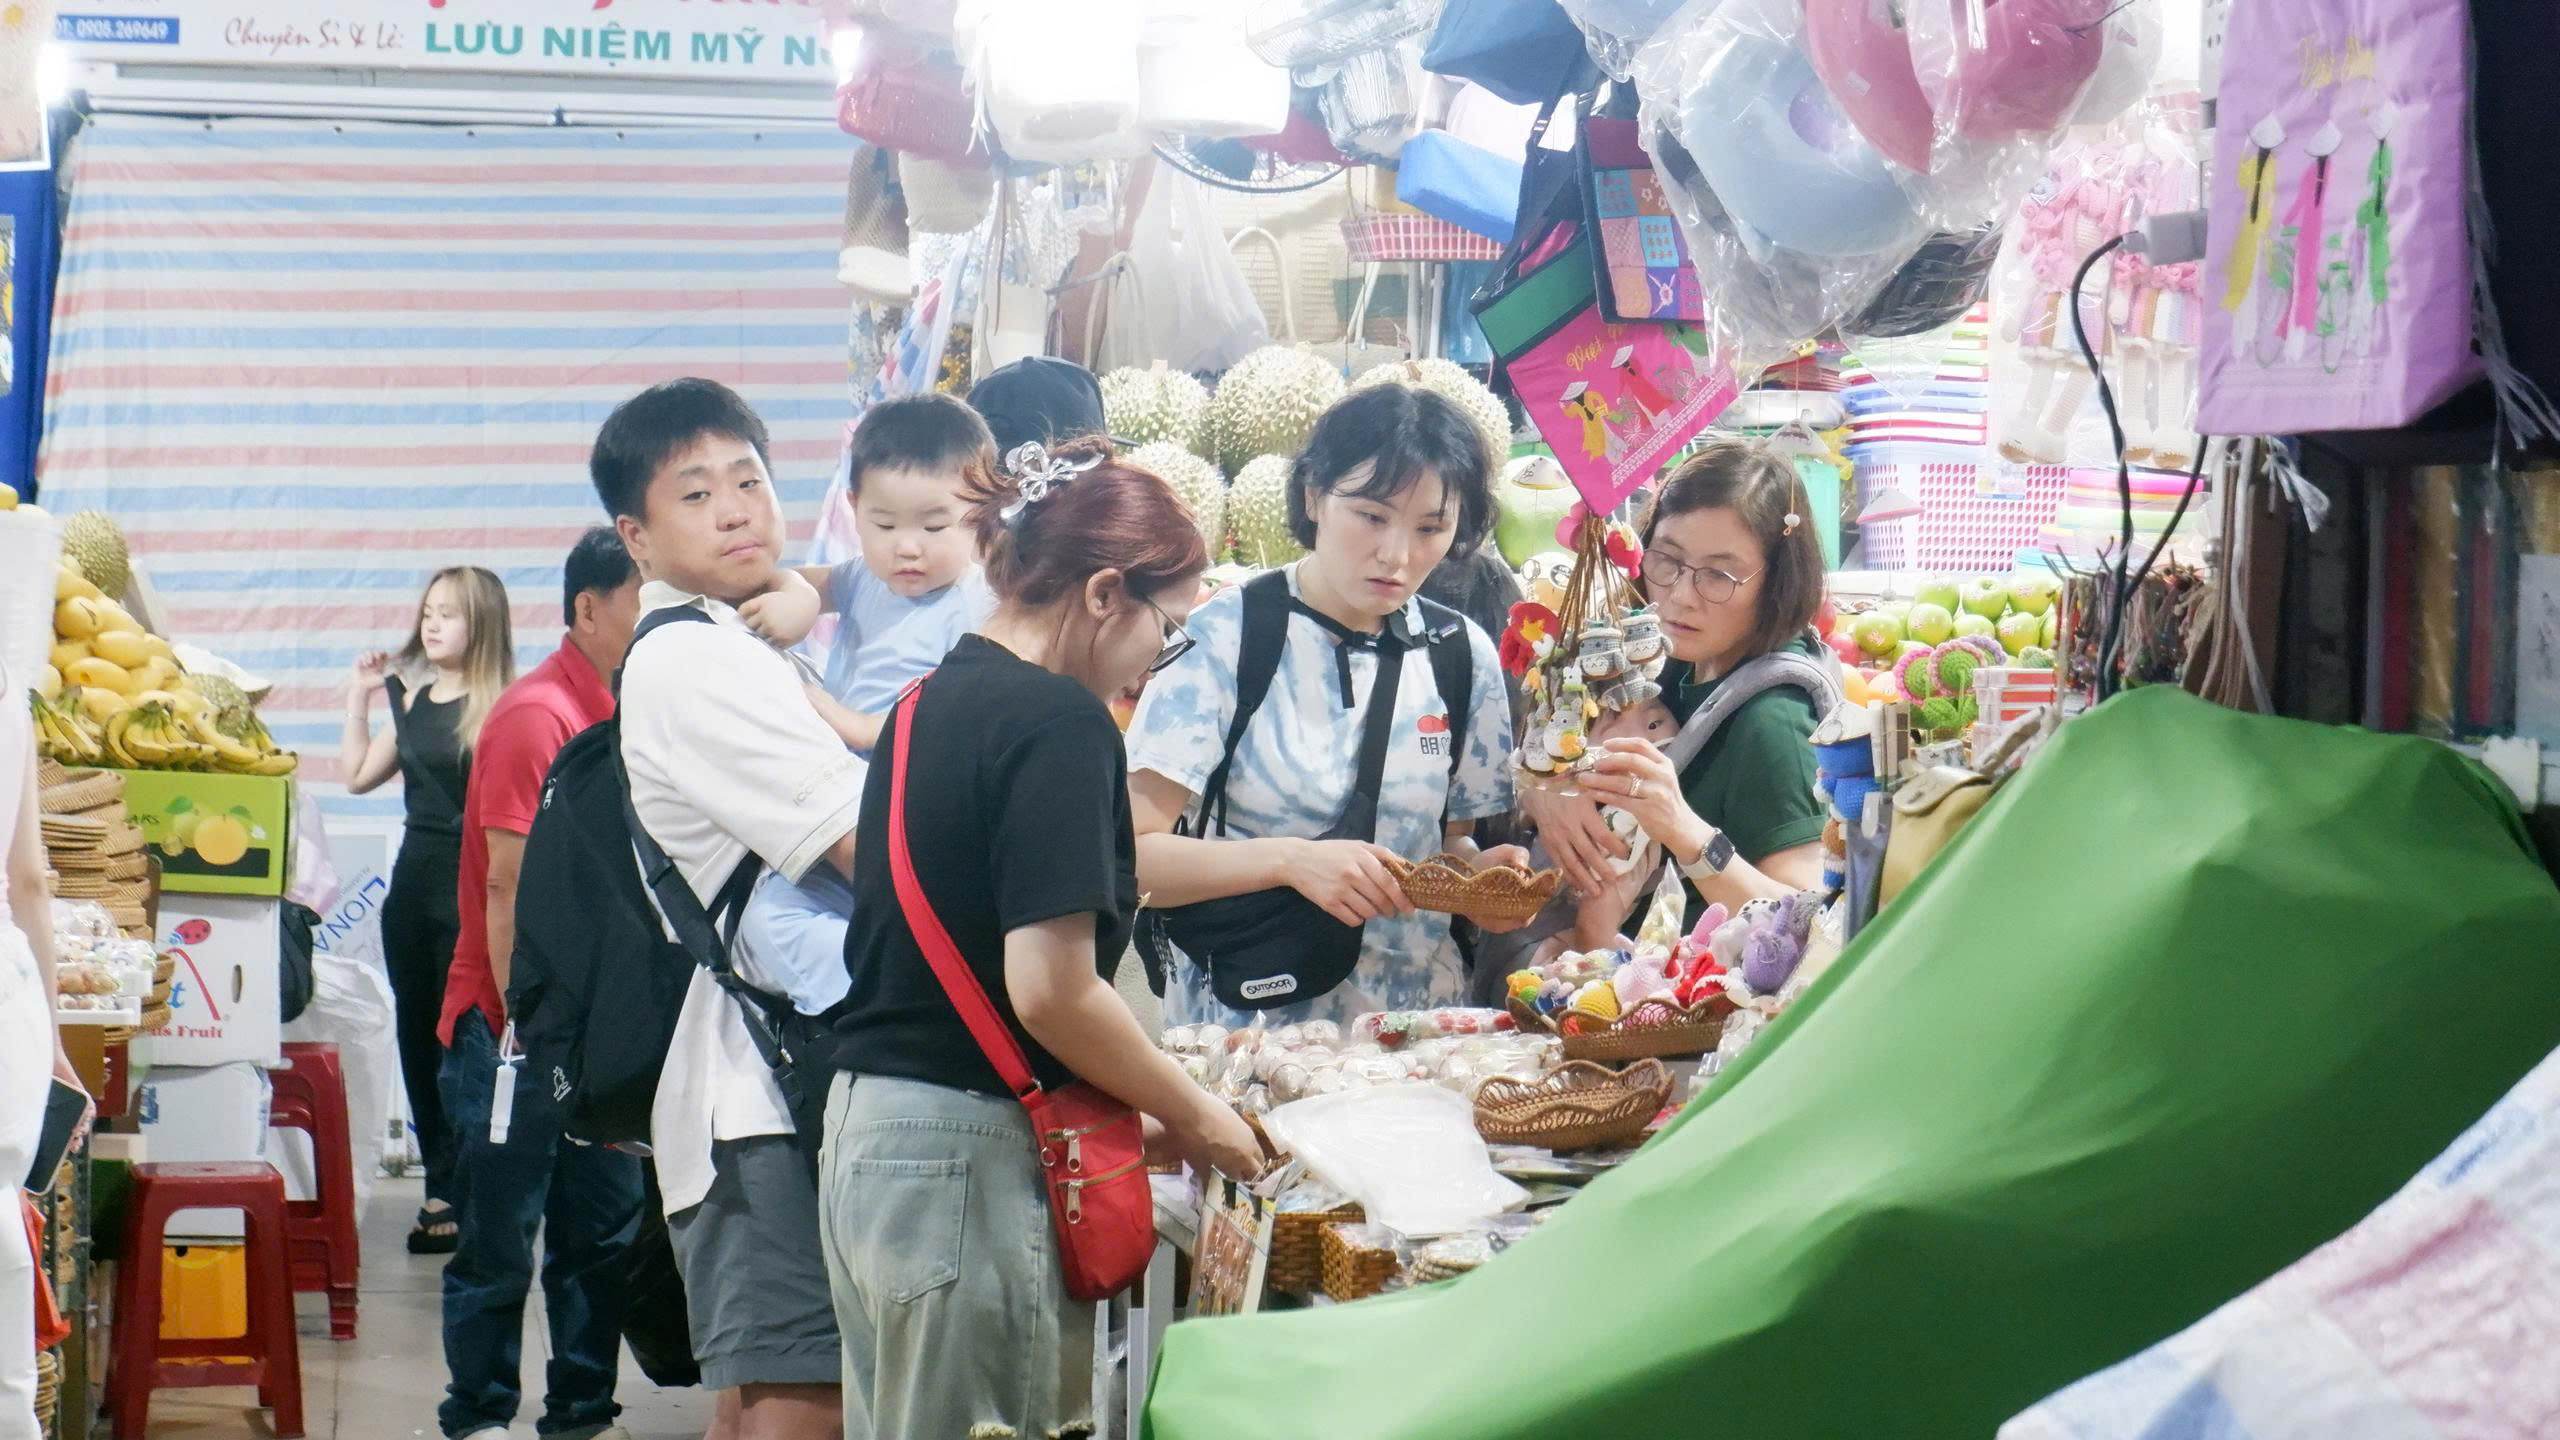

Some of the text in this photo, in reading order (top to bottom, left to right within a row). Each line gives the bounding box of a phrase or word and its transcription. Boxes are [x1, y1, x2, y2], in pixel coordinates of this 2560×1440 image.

[426, 20, 832, 67] LƯU NIỆM MỸ N
[1246, 978, 1293, 995] OUTDOOR
[177, 1024, 223, 1039] Fruit
